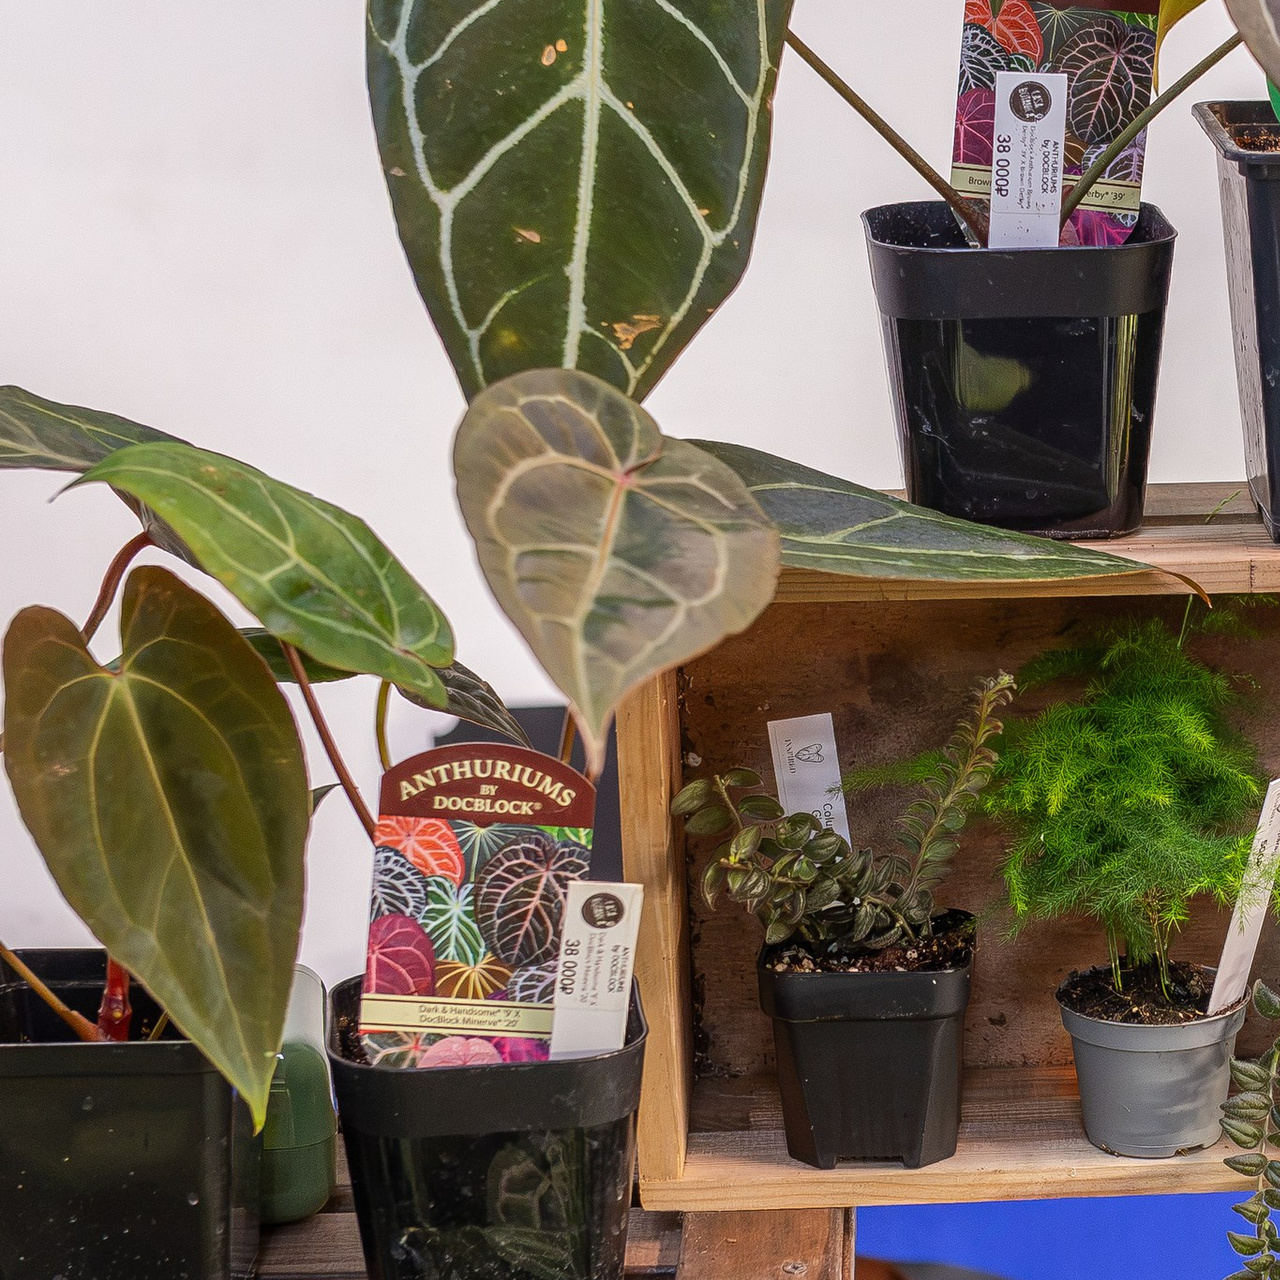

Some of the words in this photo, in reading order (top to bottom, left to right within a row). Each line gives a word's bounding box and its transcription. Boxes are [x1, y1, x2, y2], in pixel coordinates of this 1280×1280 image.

[997, 134, 1011, 153] 38
[1041, 140, 1050, 149] by
[1042, 151, 1050, 194] DOCBLOCK
[1050, 141, 1059, 193] ANTHURIUMS
[399, 759, 577, 807] ANTHURIUMS
[479, 784, 499, 795] BY
[822, 803, 834, 828] Colu
[565, 939, 581, 956] 38
